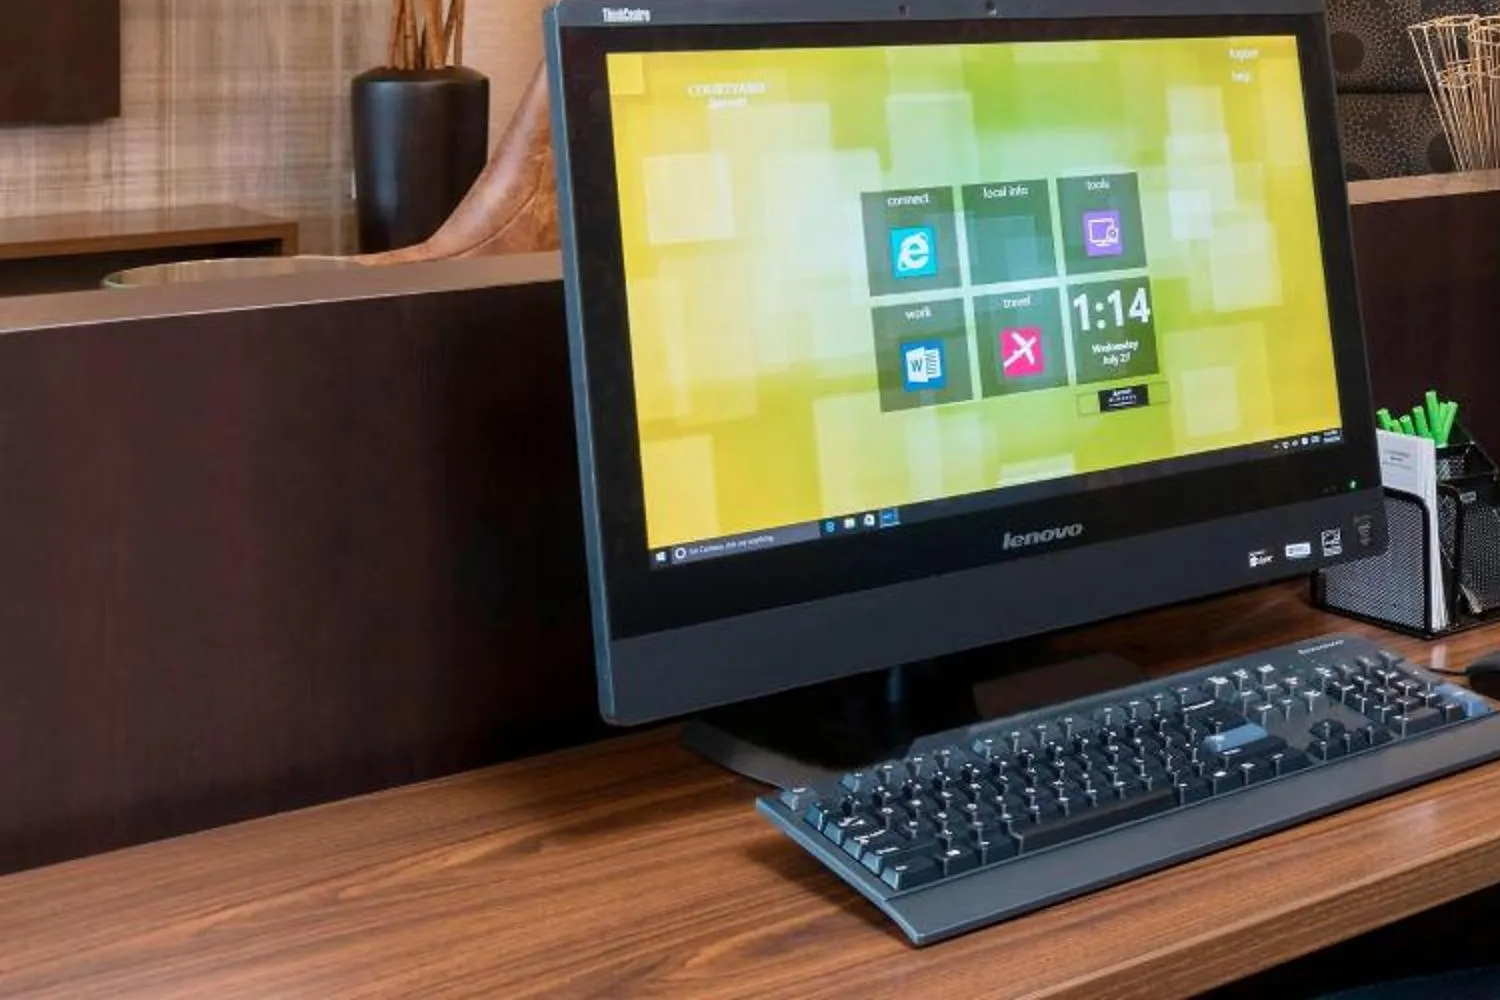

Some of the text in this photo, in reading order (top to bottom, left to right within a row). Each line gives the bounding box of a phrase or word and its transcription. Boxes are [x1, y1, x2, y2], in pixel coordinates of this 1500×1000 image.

[887, 192, 929, 207] connect
[1073, 286, 1151, 331] 1:14
[1002, 523, 1083, 550] lenovo
